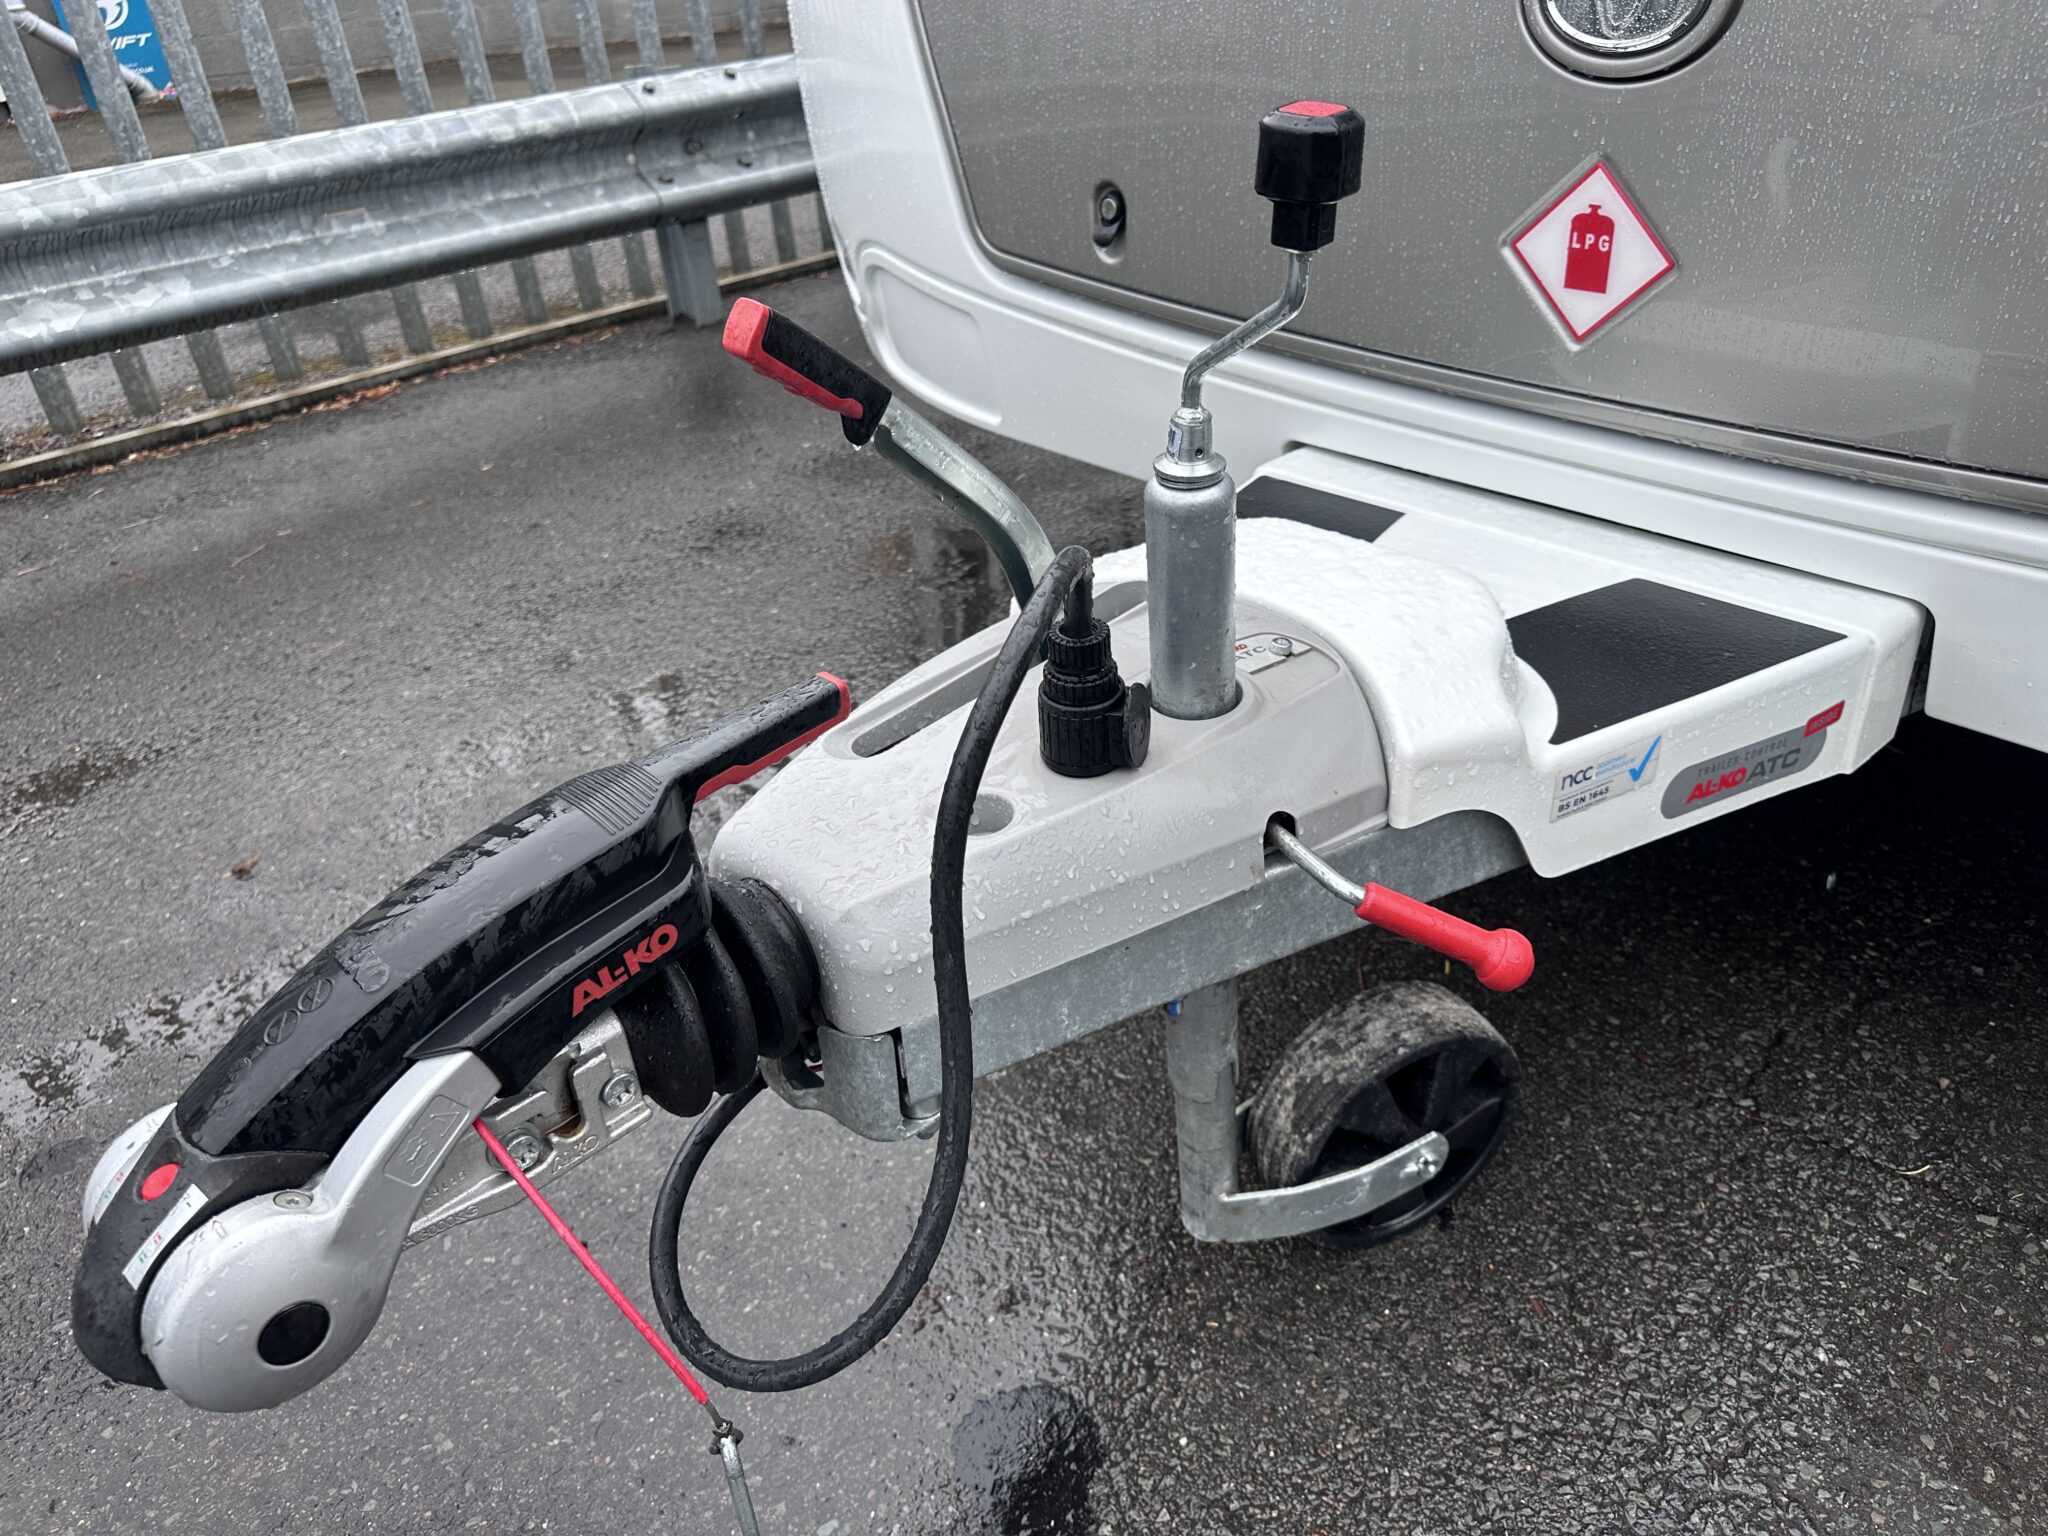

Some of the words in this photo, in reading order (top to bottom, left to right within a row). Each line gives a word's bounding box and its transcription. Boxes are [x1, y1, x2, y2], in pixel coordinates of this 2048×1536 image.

[1571, 232, 1610, 252] LPG
[1685, 767, 1747, 804] AL-KO
[1747, 748, 1801, 782] ATC
[1558, 802, 1571, 813] BS
[1573, 795, 1586, 807] EN
[1589, 786, 1610, 800] 1645
[572, 923, 679, 1018] AL-KO
